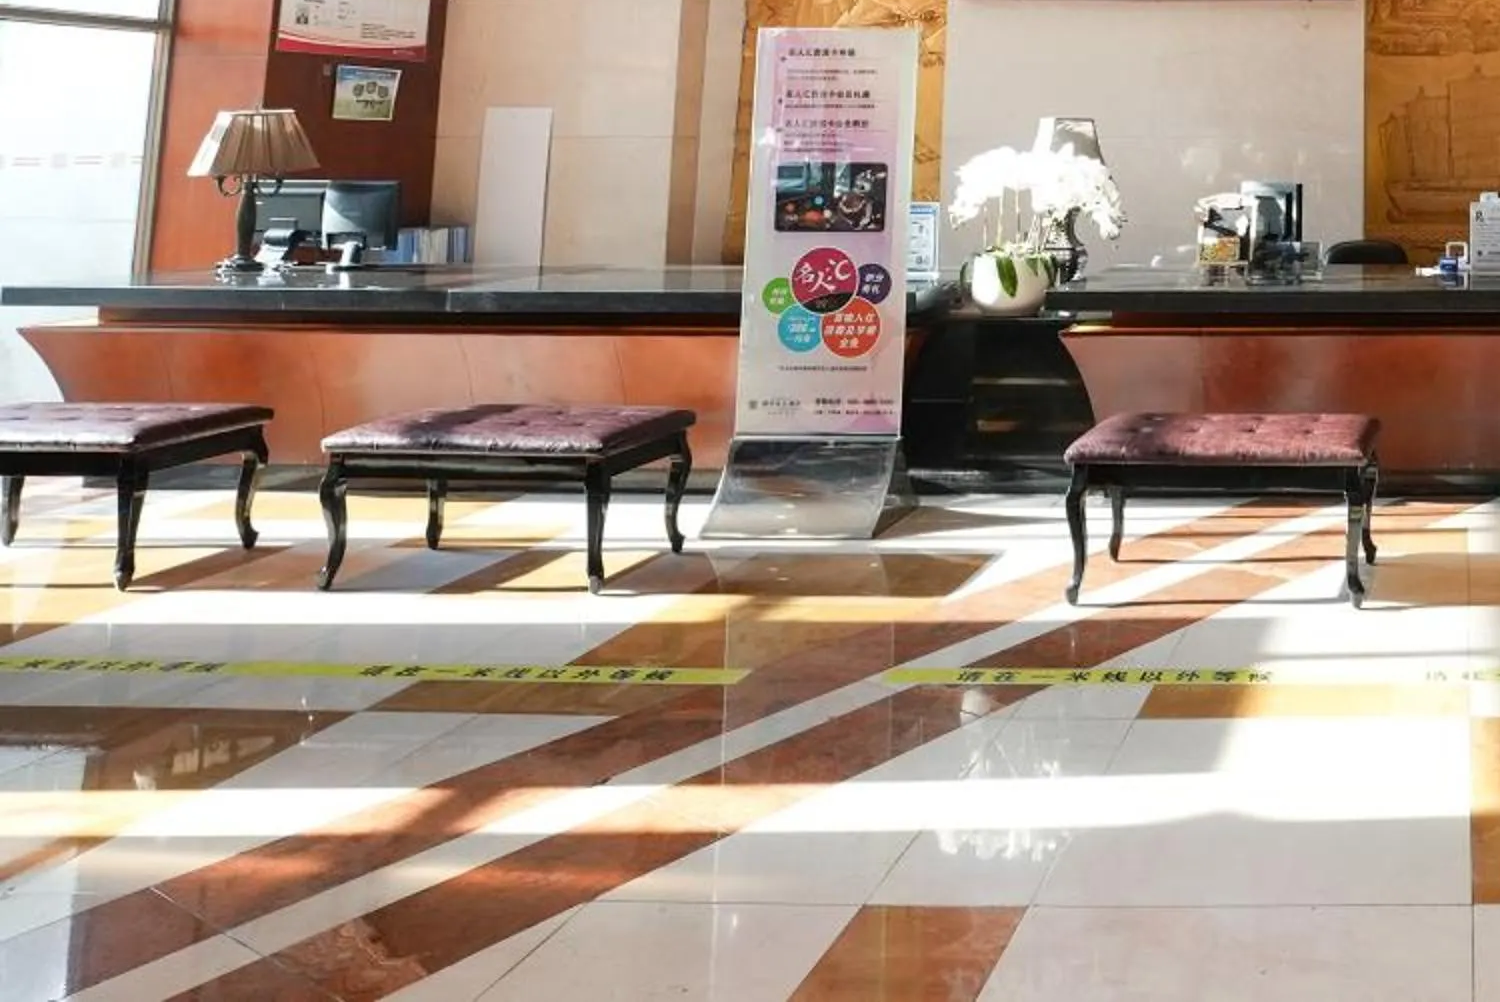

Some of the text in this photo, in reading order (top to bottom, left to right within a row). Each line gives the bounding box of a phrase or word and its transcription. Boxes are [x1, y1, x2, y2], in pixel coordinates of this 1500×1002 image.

[0, 659, 228, 673] 米线以外等候
[361, 665, 674, 680] 请在一米线以外等候
[957, 669, 1273, 684] 请在一米线以外等候
